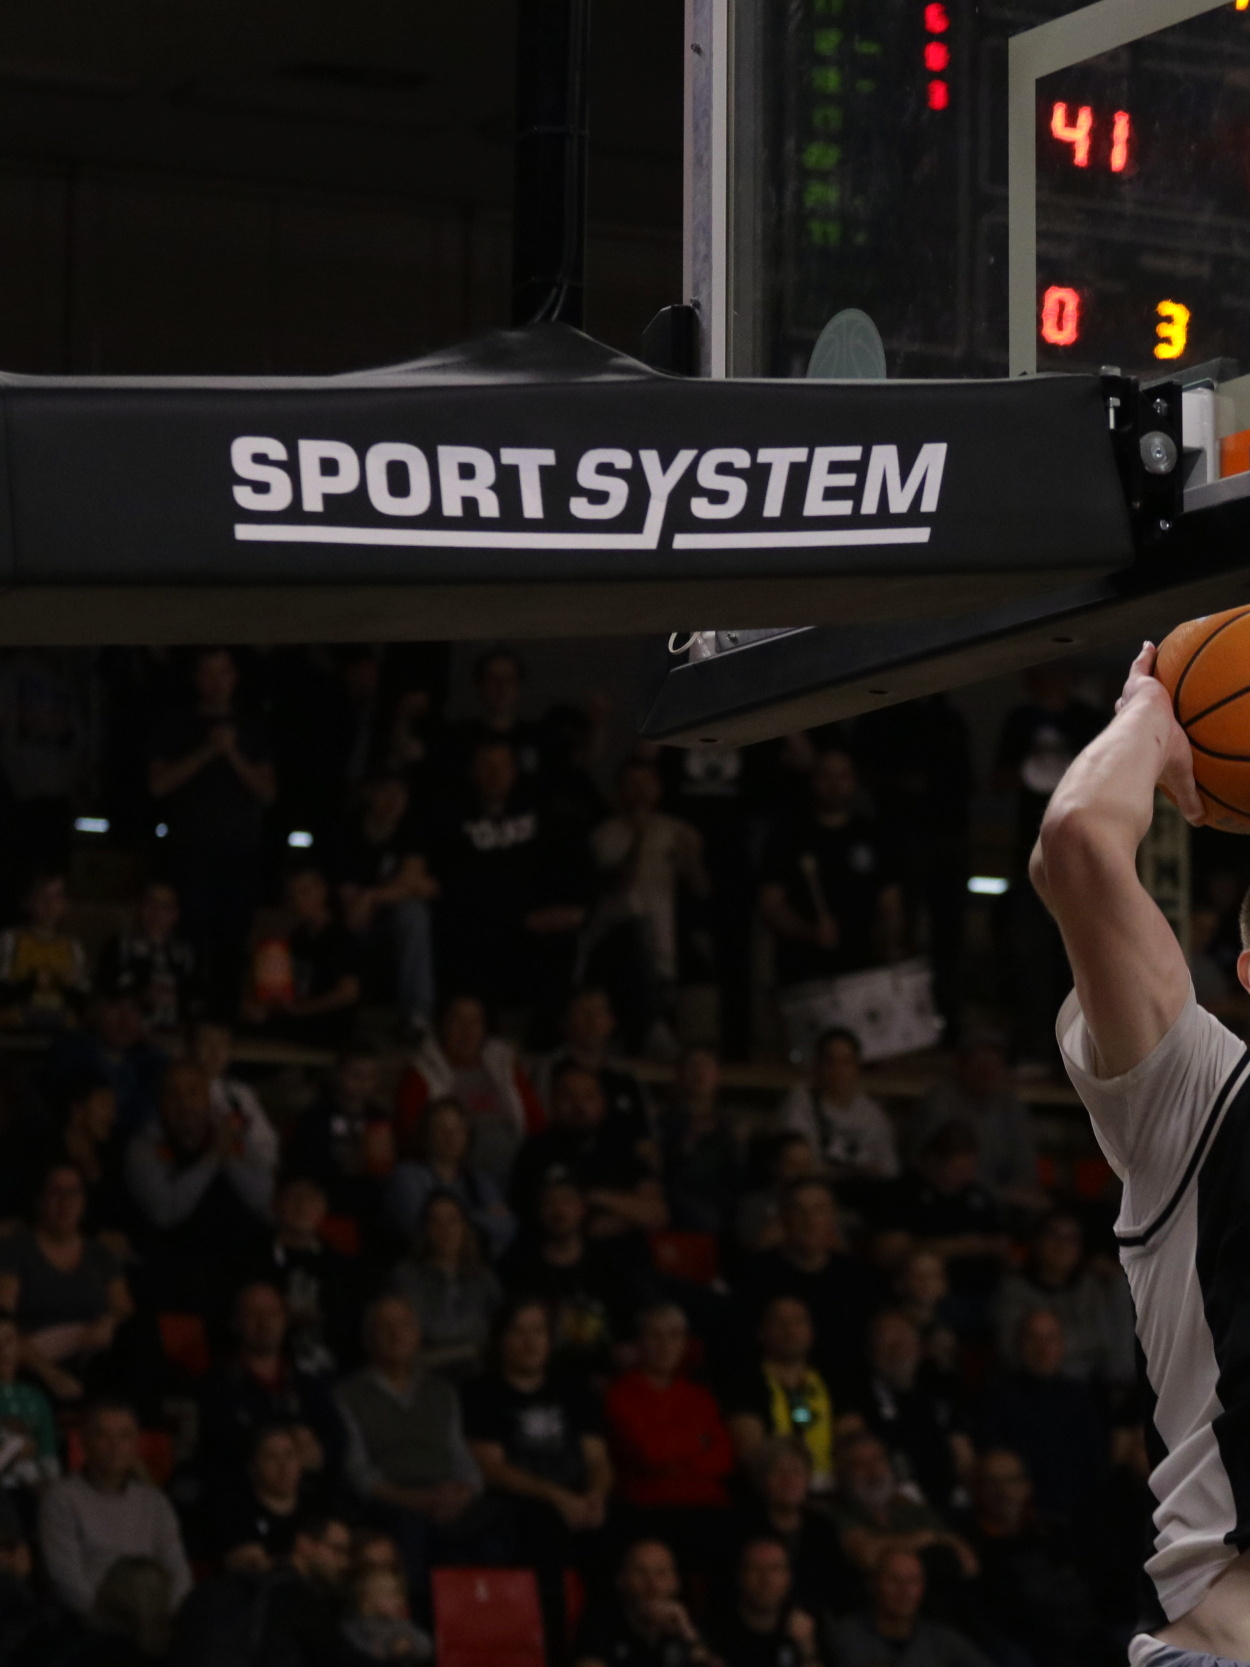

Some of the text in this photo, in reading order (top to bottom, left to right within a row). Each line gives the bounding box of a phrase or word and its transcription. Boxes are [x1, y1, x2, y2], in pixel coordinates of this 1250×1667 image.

[1051, 102, 1130, 172] 41
[1041, 286, 1080, 346] 0
[1153, 300, 1191, 360] 3
[230, 436, 948, 549] SPORT SYSTEM
